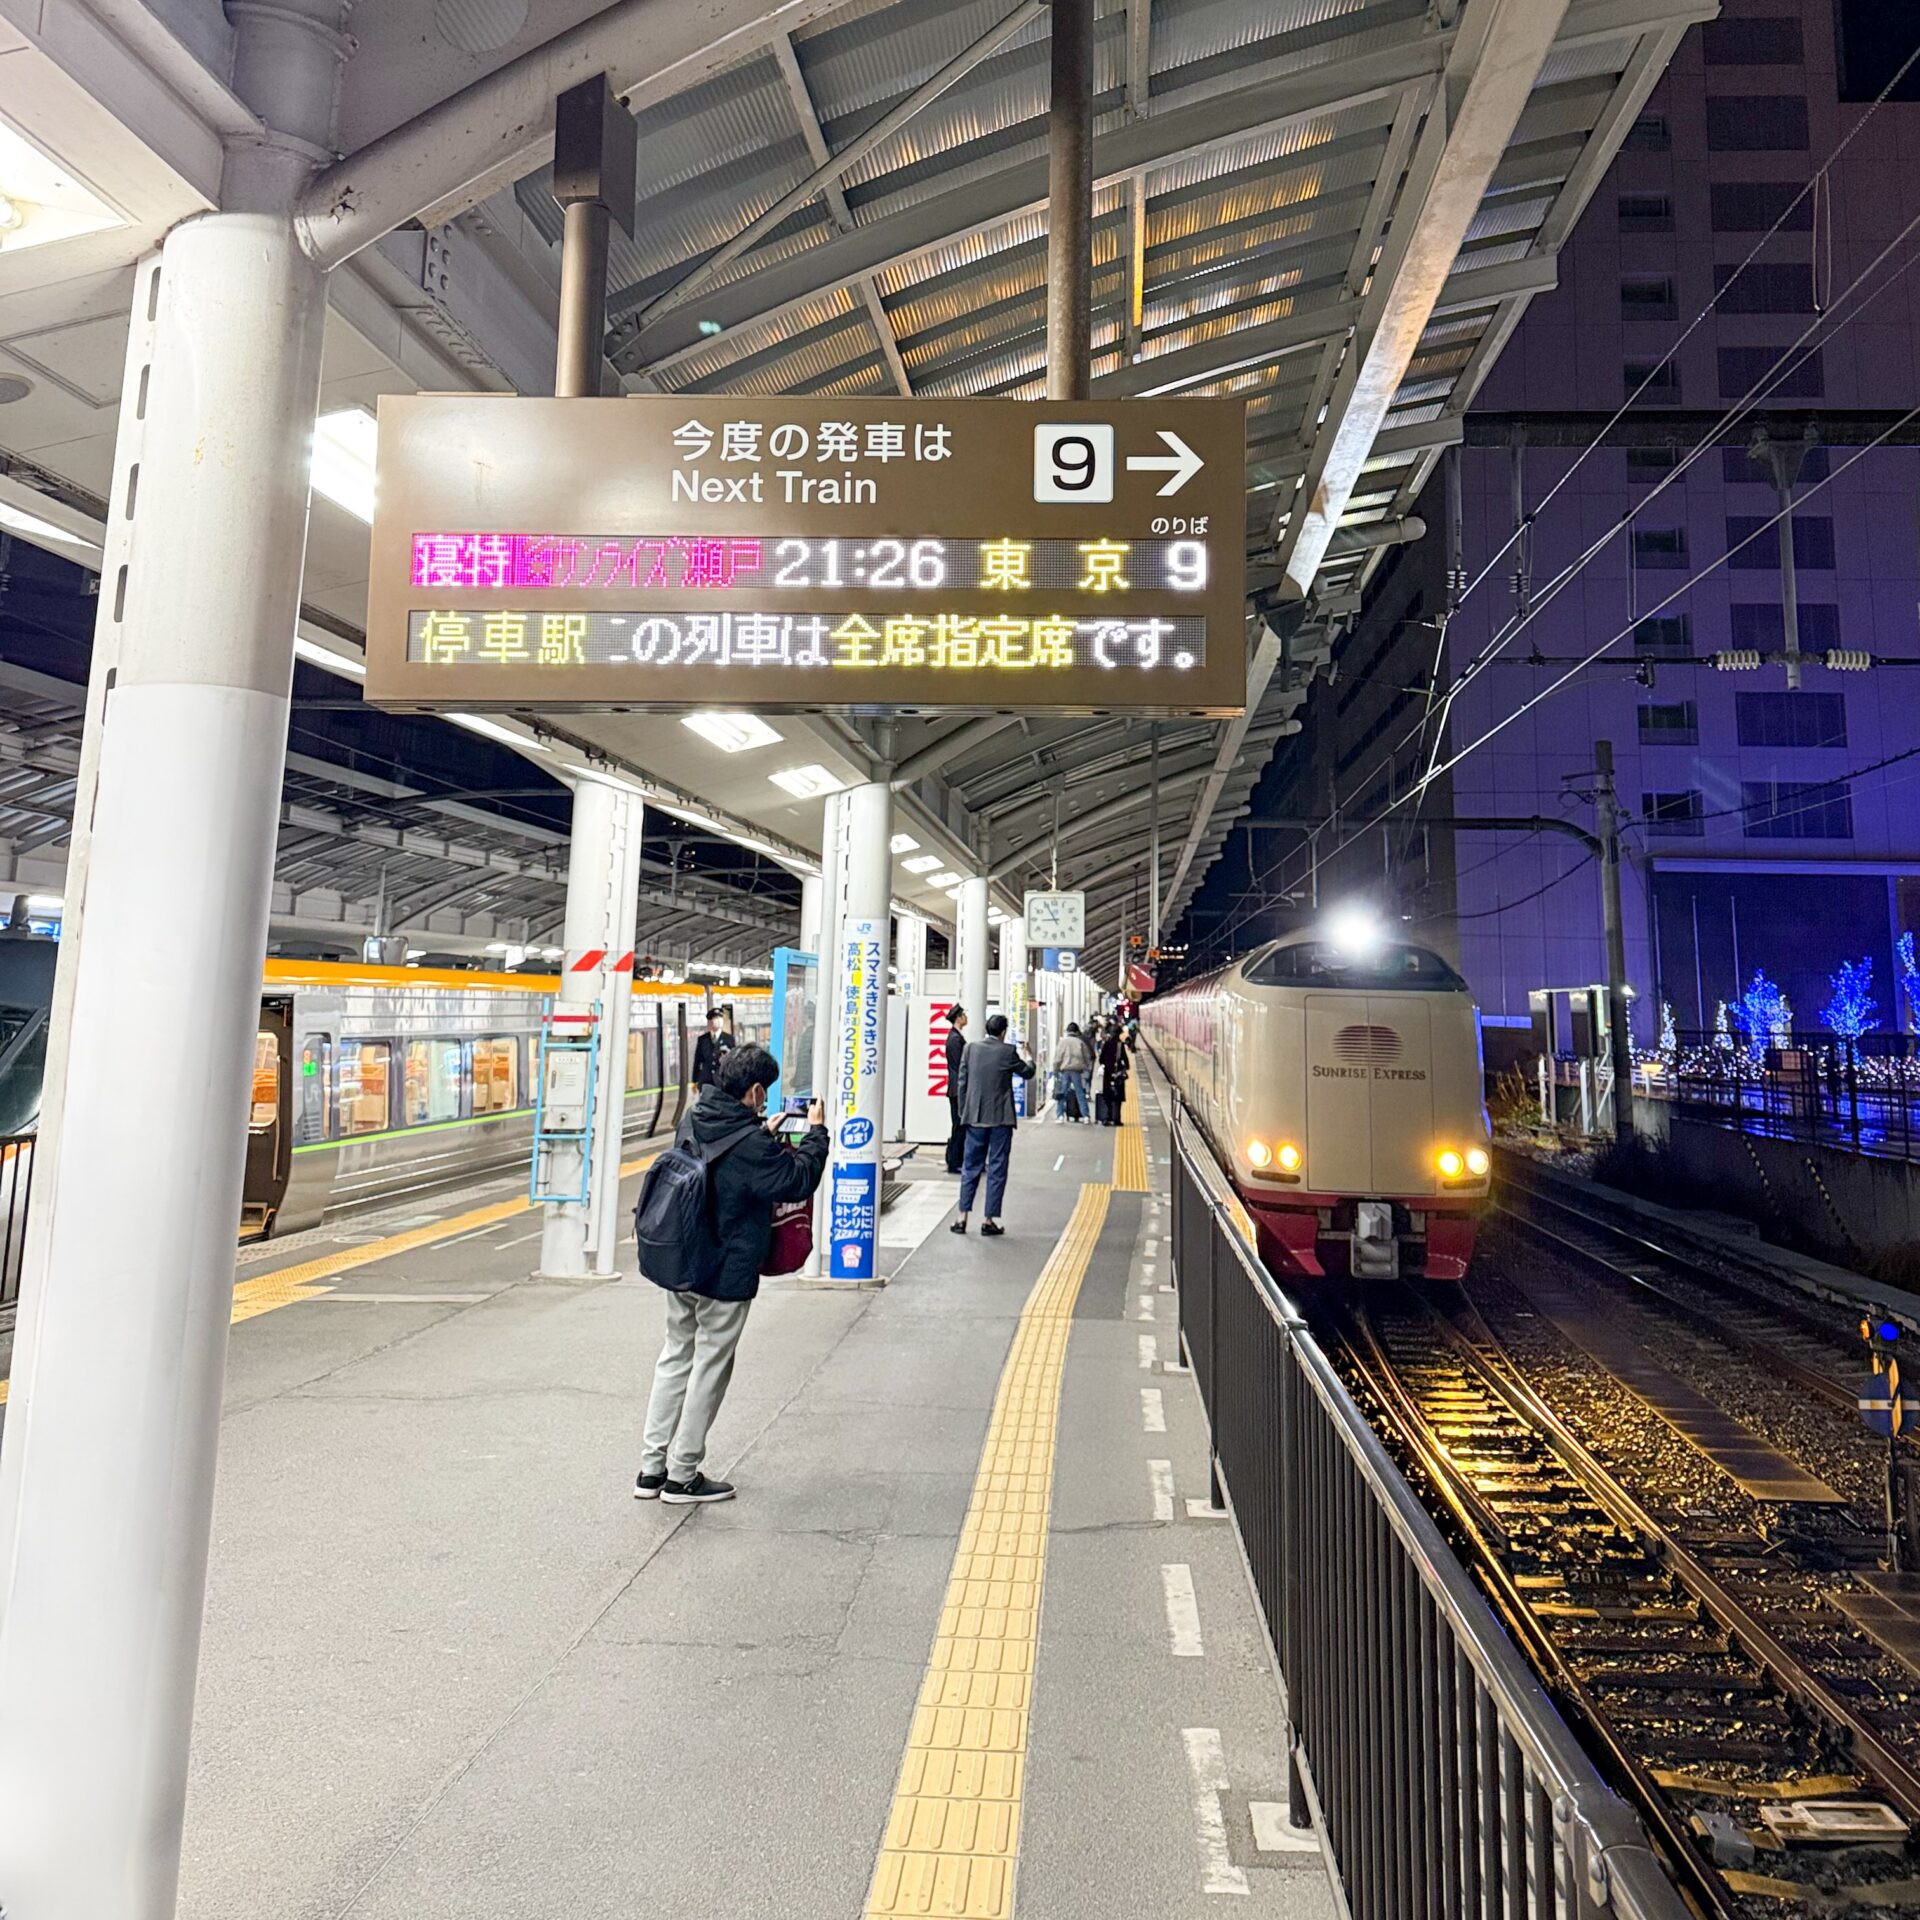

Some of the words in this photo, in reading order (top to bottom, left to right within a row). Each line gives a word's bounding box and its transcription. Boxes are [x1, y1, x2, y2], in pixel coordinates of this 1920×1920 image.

[672, 420, 952, 463] 今度の発車は
[1052, 437, 1095, 490] 9
[671, 470, 763, 502] Next
[776, 471, 877, 503] Train
[1151, 517, 1208, 535] のりば
[774, 540, 945, 588] 21:26
[1167, 540, 1208, 589] 9
[420, 611, 587, 665] 停車駅
[1057, 951, 1076, 972] 9
[928, 1003, 953, 1097] KIRIN
[1313, 1065, 1367, 1079] SUNRISE
[1373, 1067, 1427, 1081] EXPRESS
